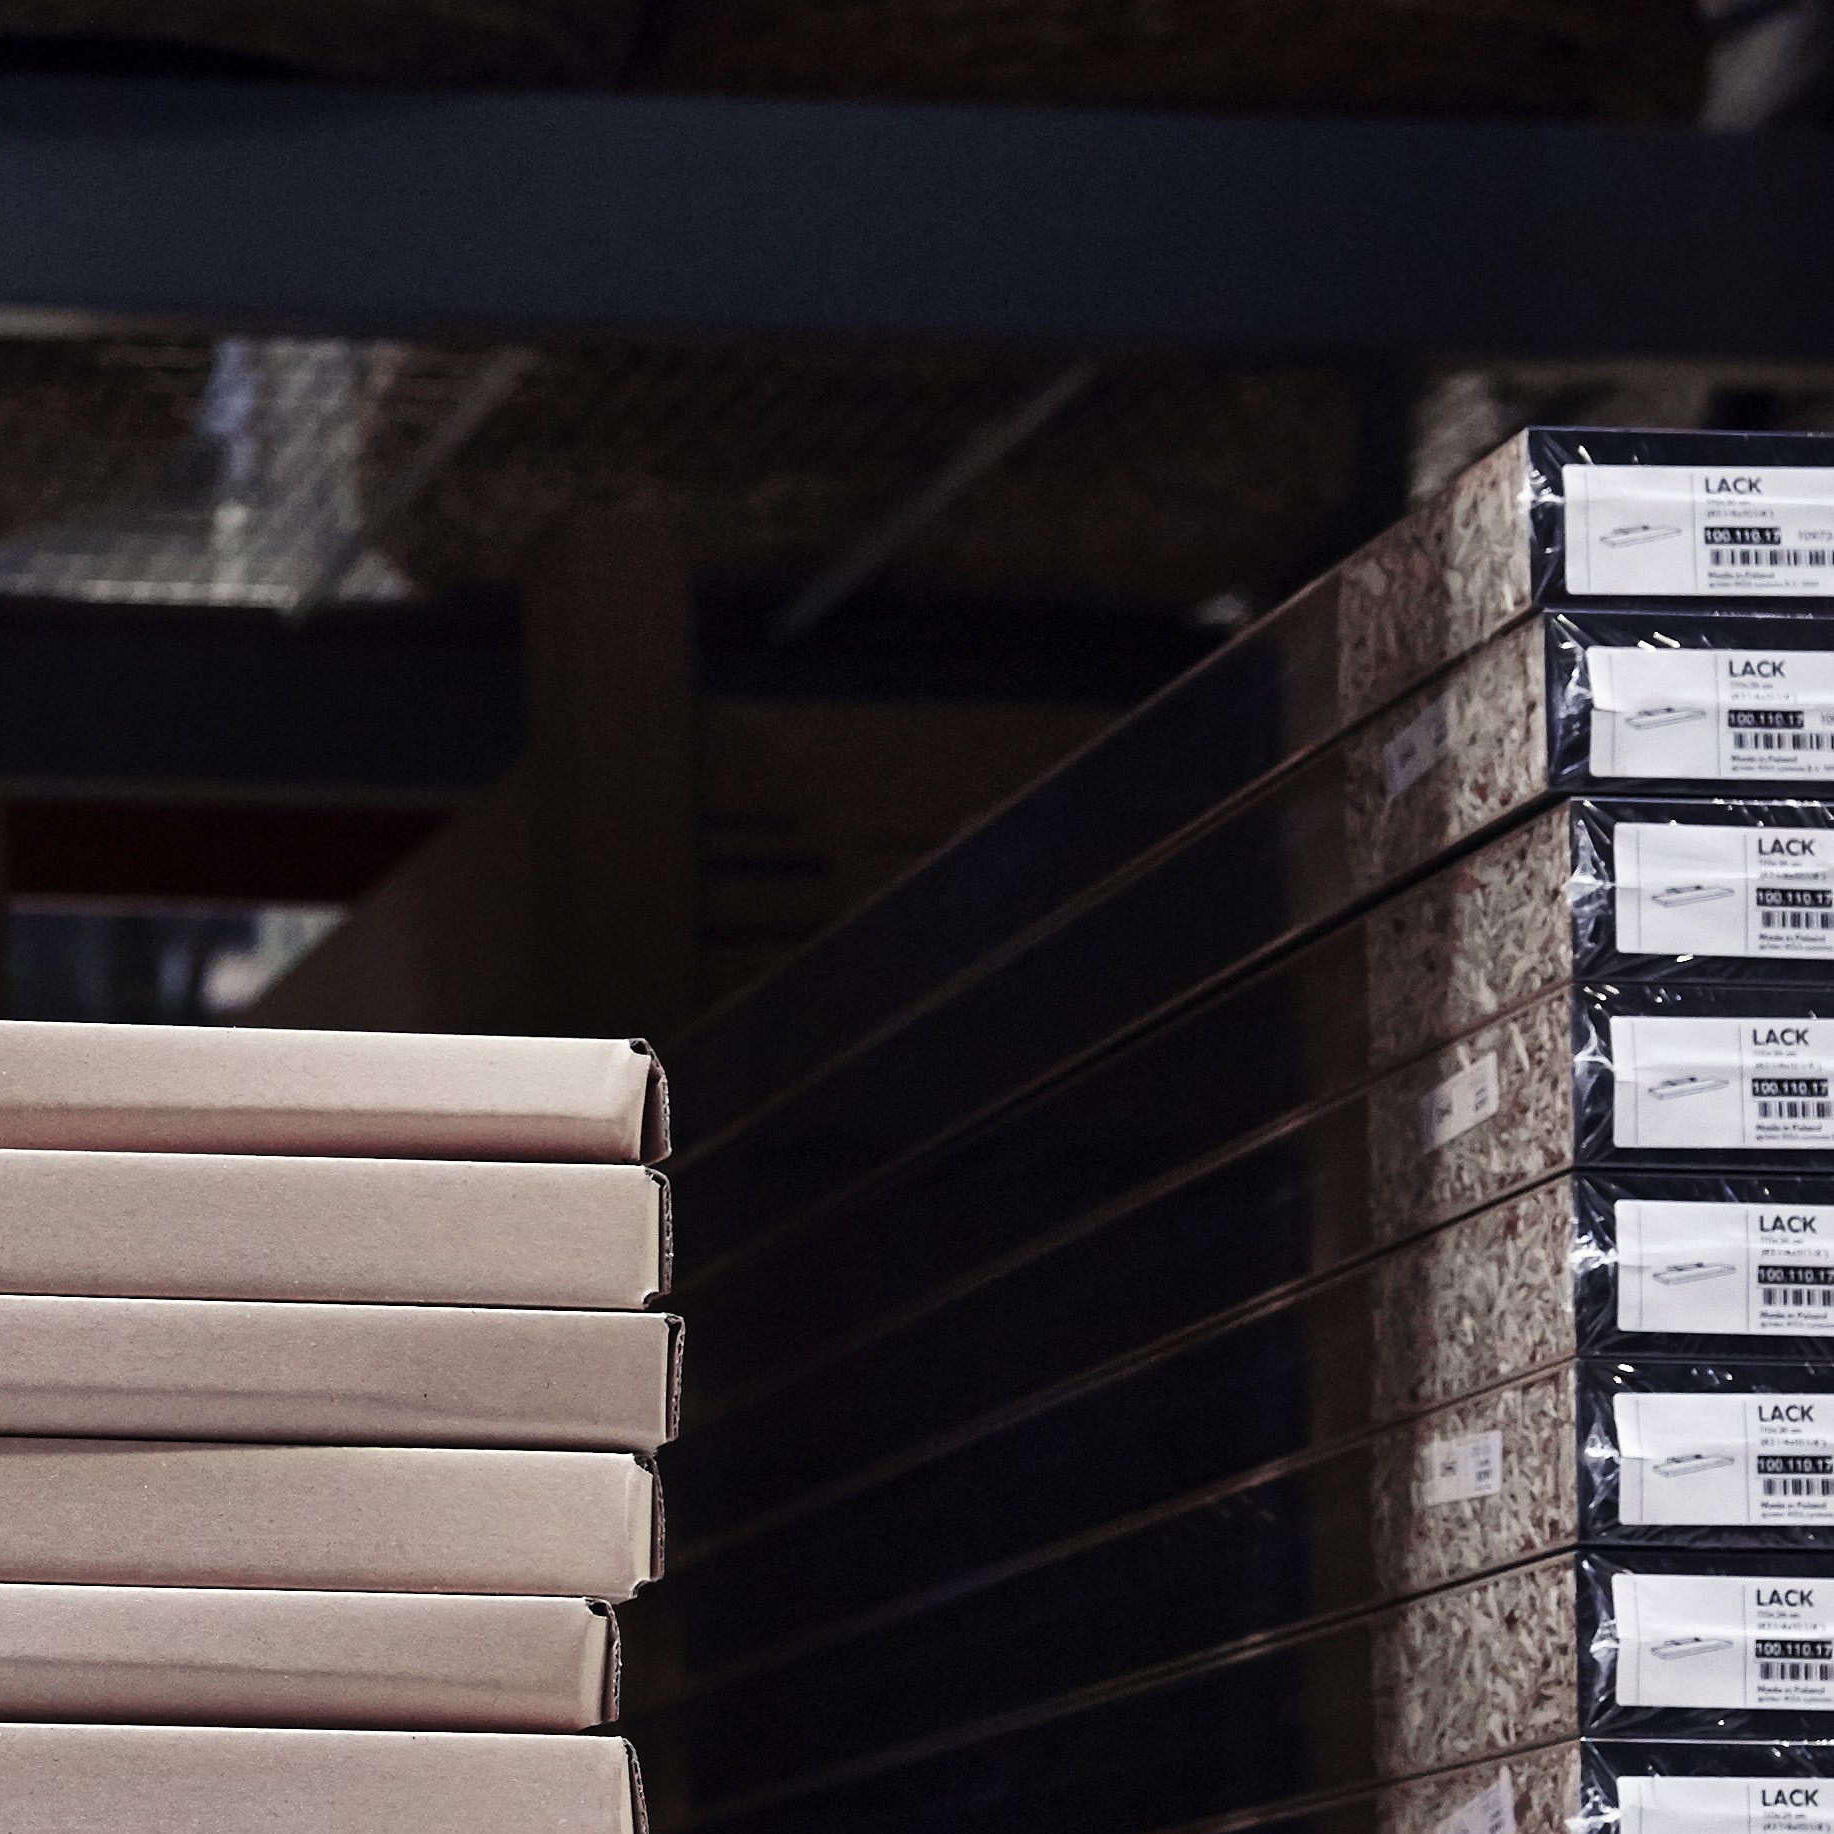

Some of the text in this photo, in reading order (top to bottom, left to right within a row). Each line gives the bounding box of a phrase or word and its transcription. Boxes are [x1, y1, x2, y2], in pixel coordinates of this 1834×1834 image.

[1705, 477, 1761, 494] LACK
[1728, 660, 1784, 678] LACK
[1758, 838, 1814, 857] LACK
[1752, 1028, 1809, 1046] LACK
[1759, 1215, 1816, 1233] LACK
[1758, 1405, 1814, 1423] LACK
[1756, 1589, 1813, 1607] LACK
[1761, 1788, 1819, 1807] LACK
